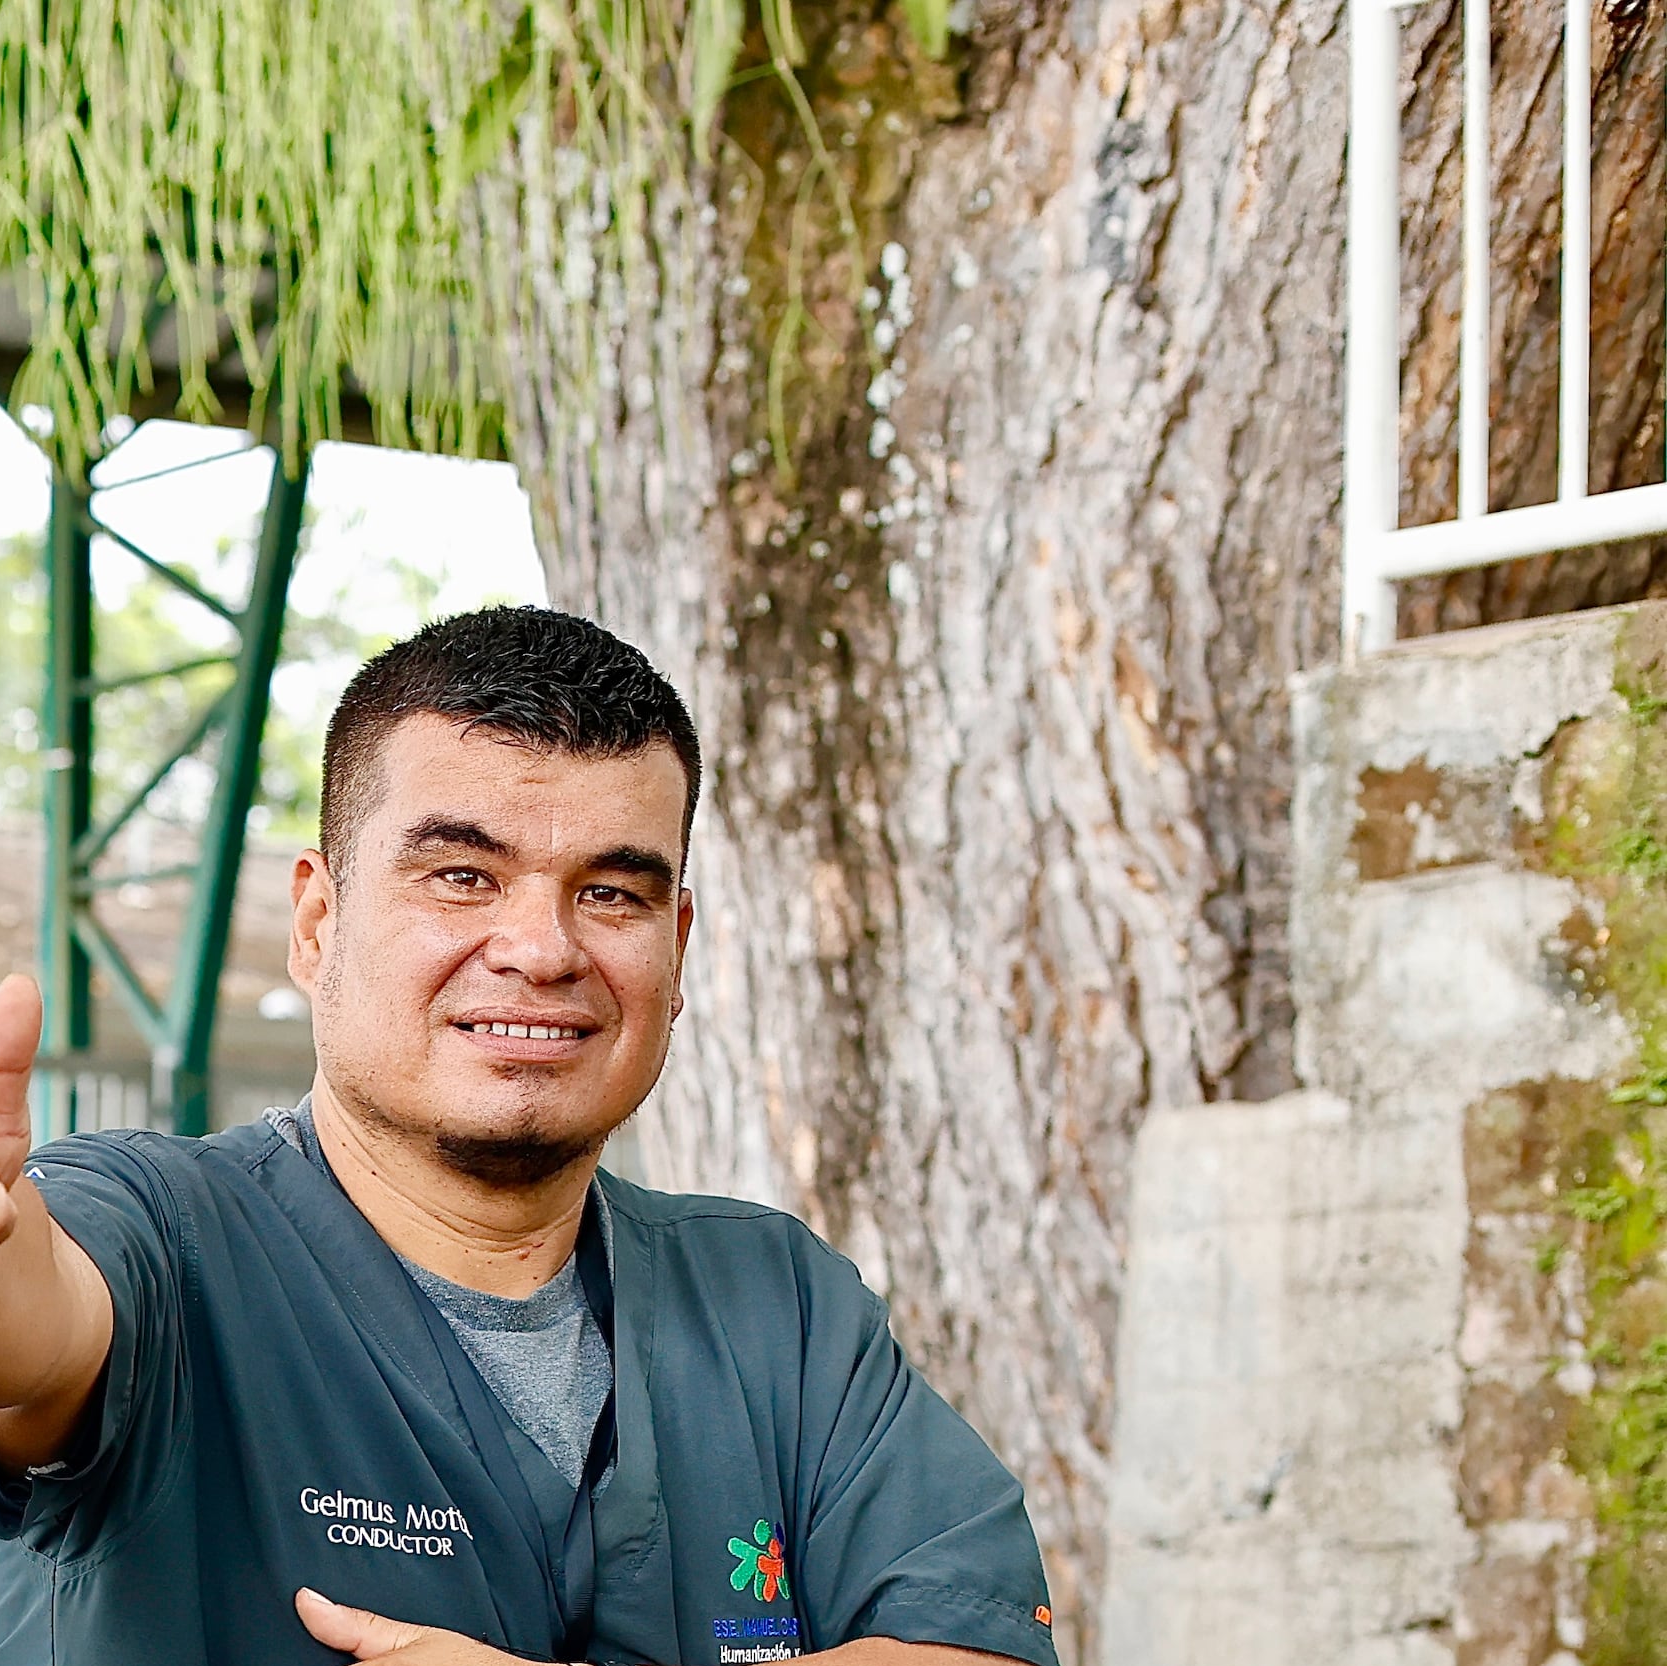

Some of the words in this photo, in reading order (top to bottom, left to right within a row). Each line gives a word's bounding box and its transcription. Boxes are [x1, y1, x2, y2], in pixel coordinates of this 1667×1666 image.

[300, 1487, 397, 1524] Gelmus
[327, 1524, 454, 1556] CONDUCTOR
[720, 1641, 791, 1664] Humanización
